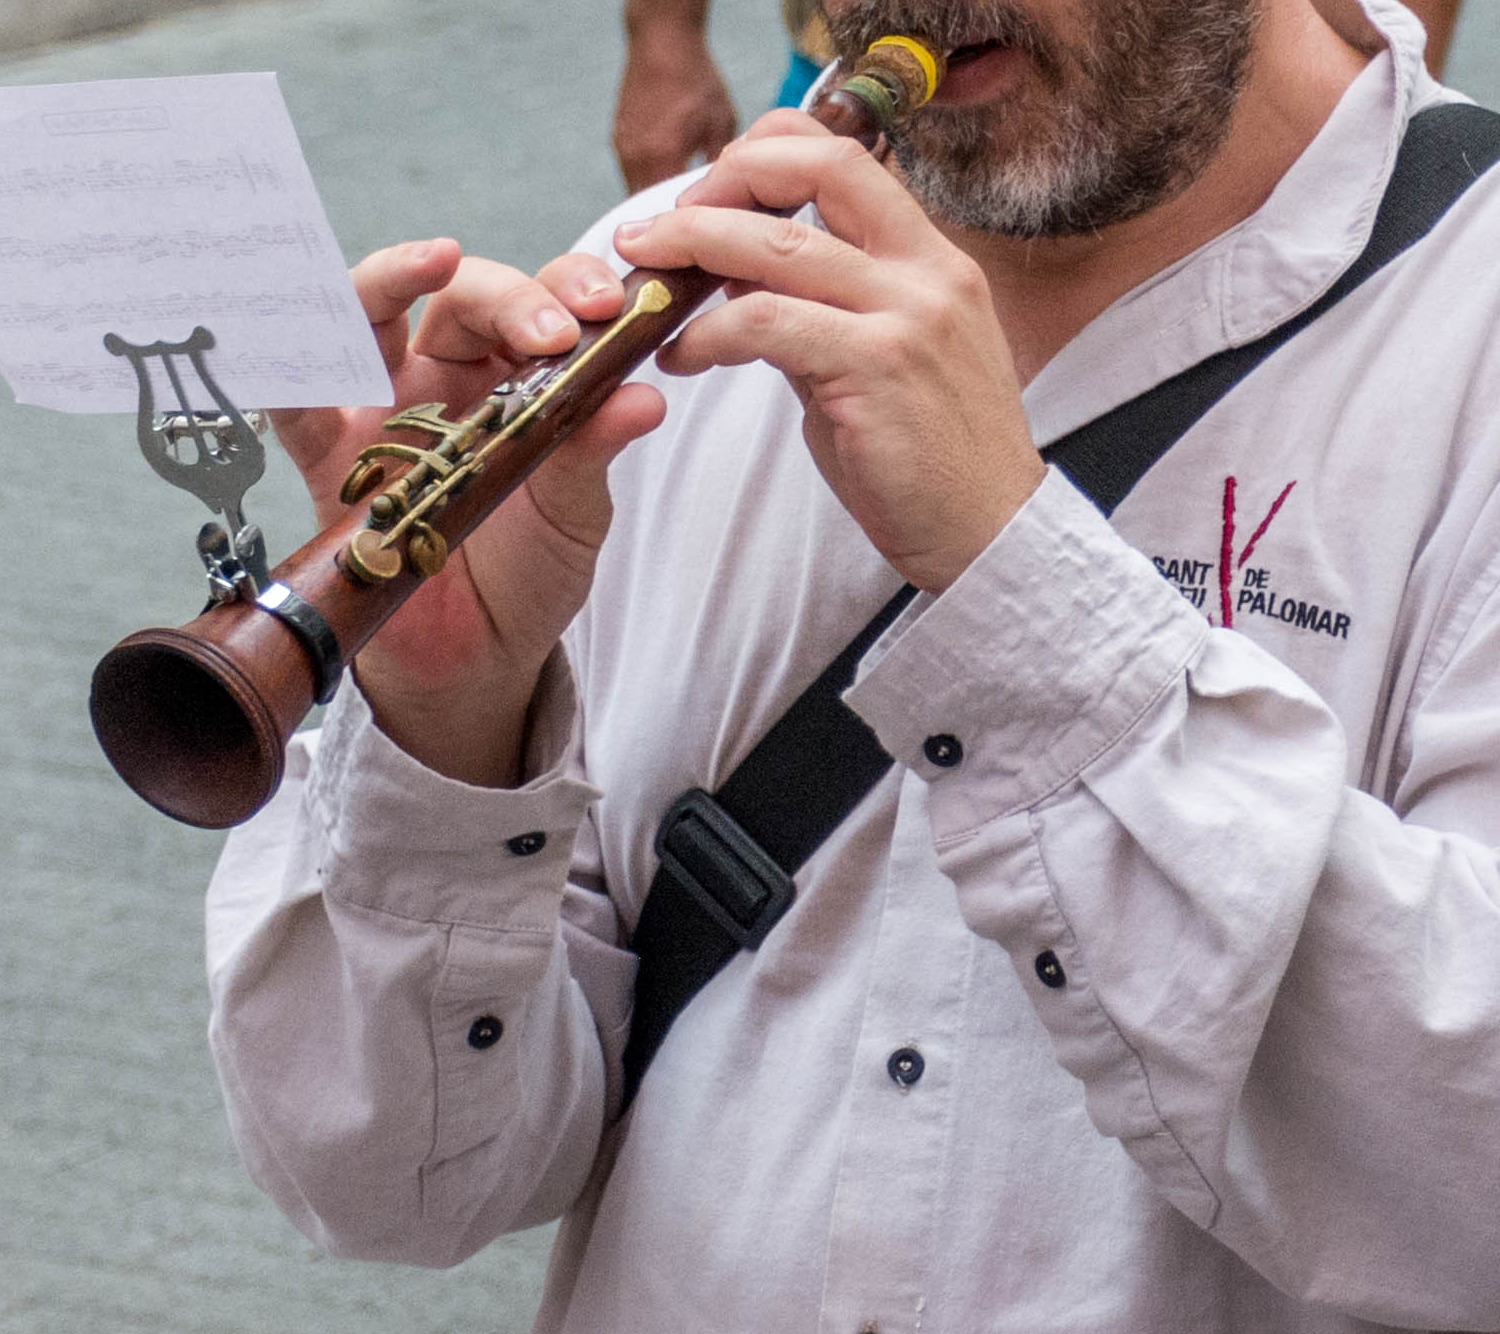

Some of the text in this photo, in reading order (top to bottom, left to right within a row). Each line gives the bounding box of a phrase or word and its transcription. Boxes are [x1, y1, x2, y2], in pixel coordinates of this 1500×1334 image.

[1152, 556, 1214, 585] SANT
[1244, 568, 1270, 589] DE
[1237, 589, 1350, 640] PALOMAR
